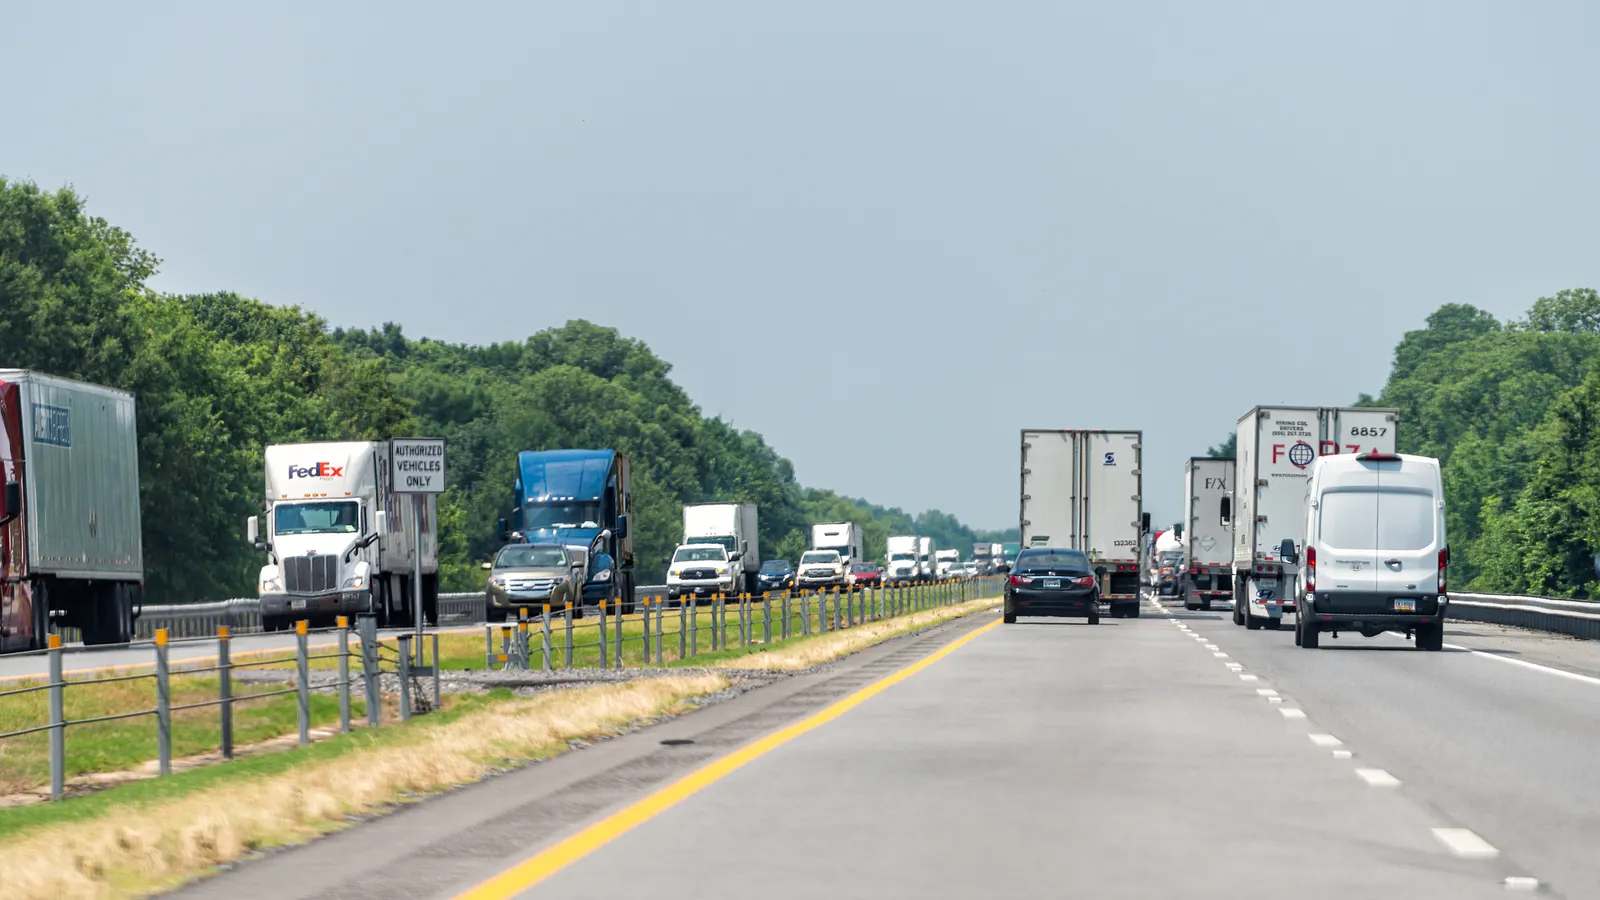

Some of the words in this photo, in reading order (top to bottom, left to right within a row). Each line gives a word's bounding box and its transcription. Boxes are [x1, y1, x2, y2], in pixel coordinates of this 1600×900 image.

[1350, 426, 1388, 437] 8857
[395, 445, 443, 456] AUTHORIZED
[1272, 440, 1380, 470] FOR
[288, 461, 343, 479] FedEx
[397, 460, 441, 471] VEHICLES
[406, 475, 432, 486] ONLY
